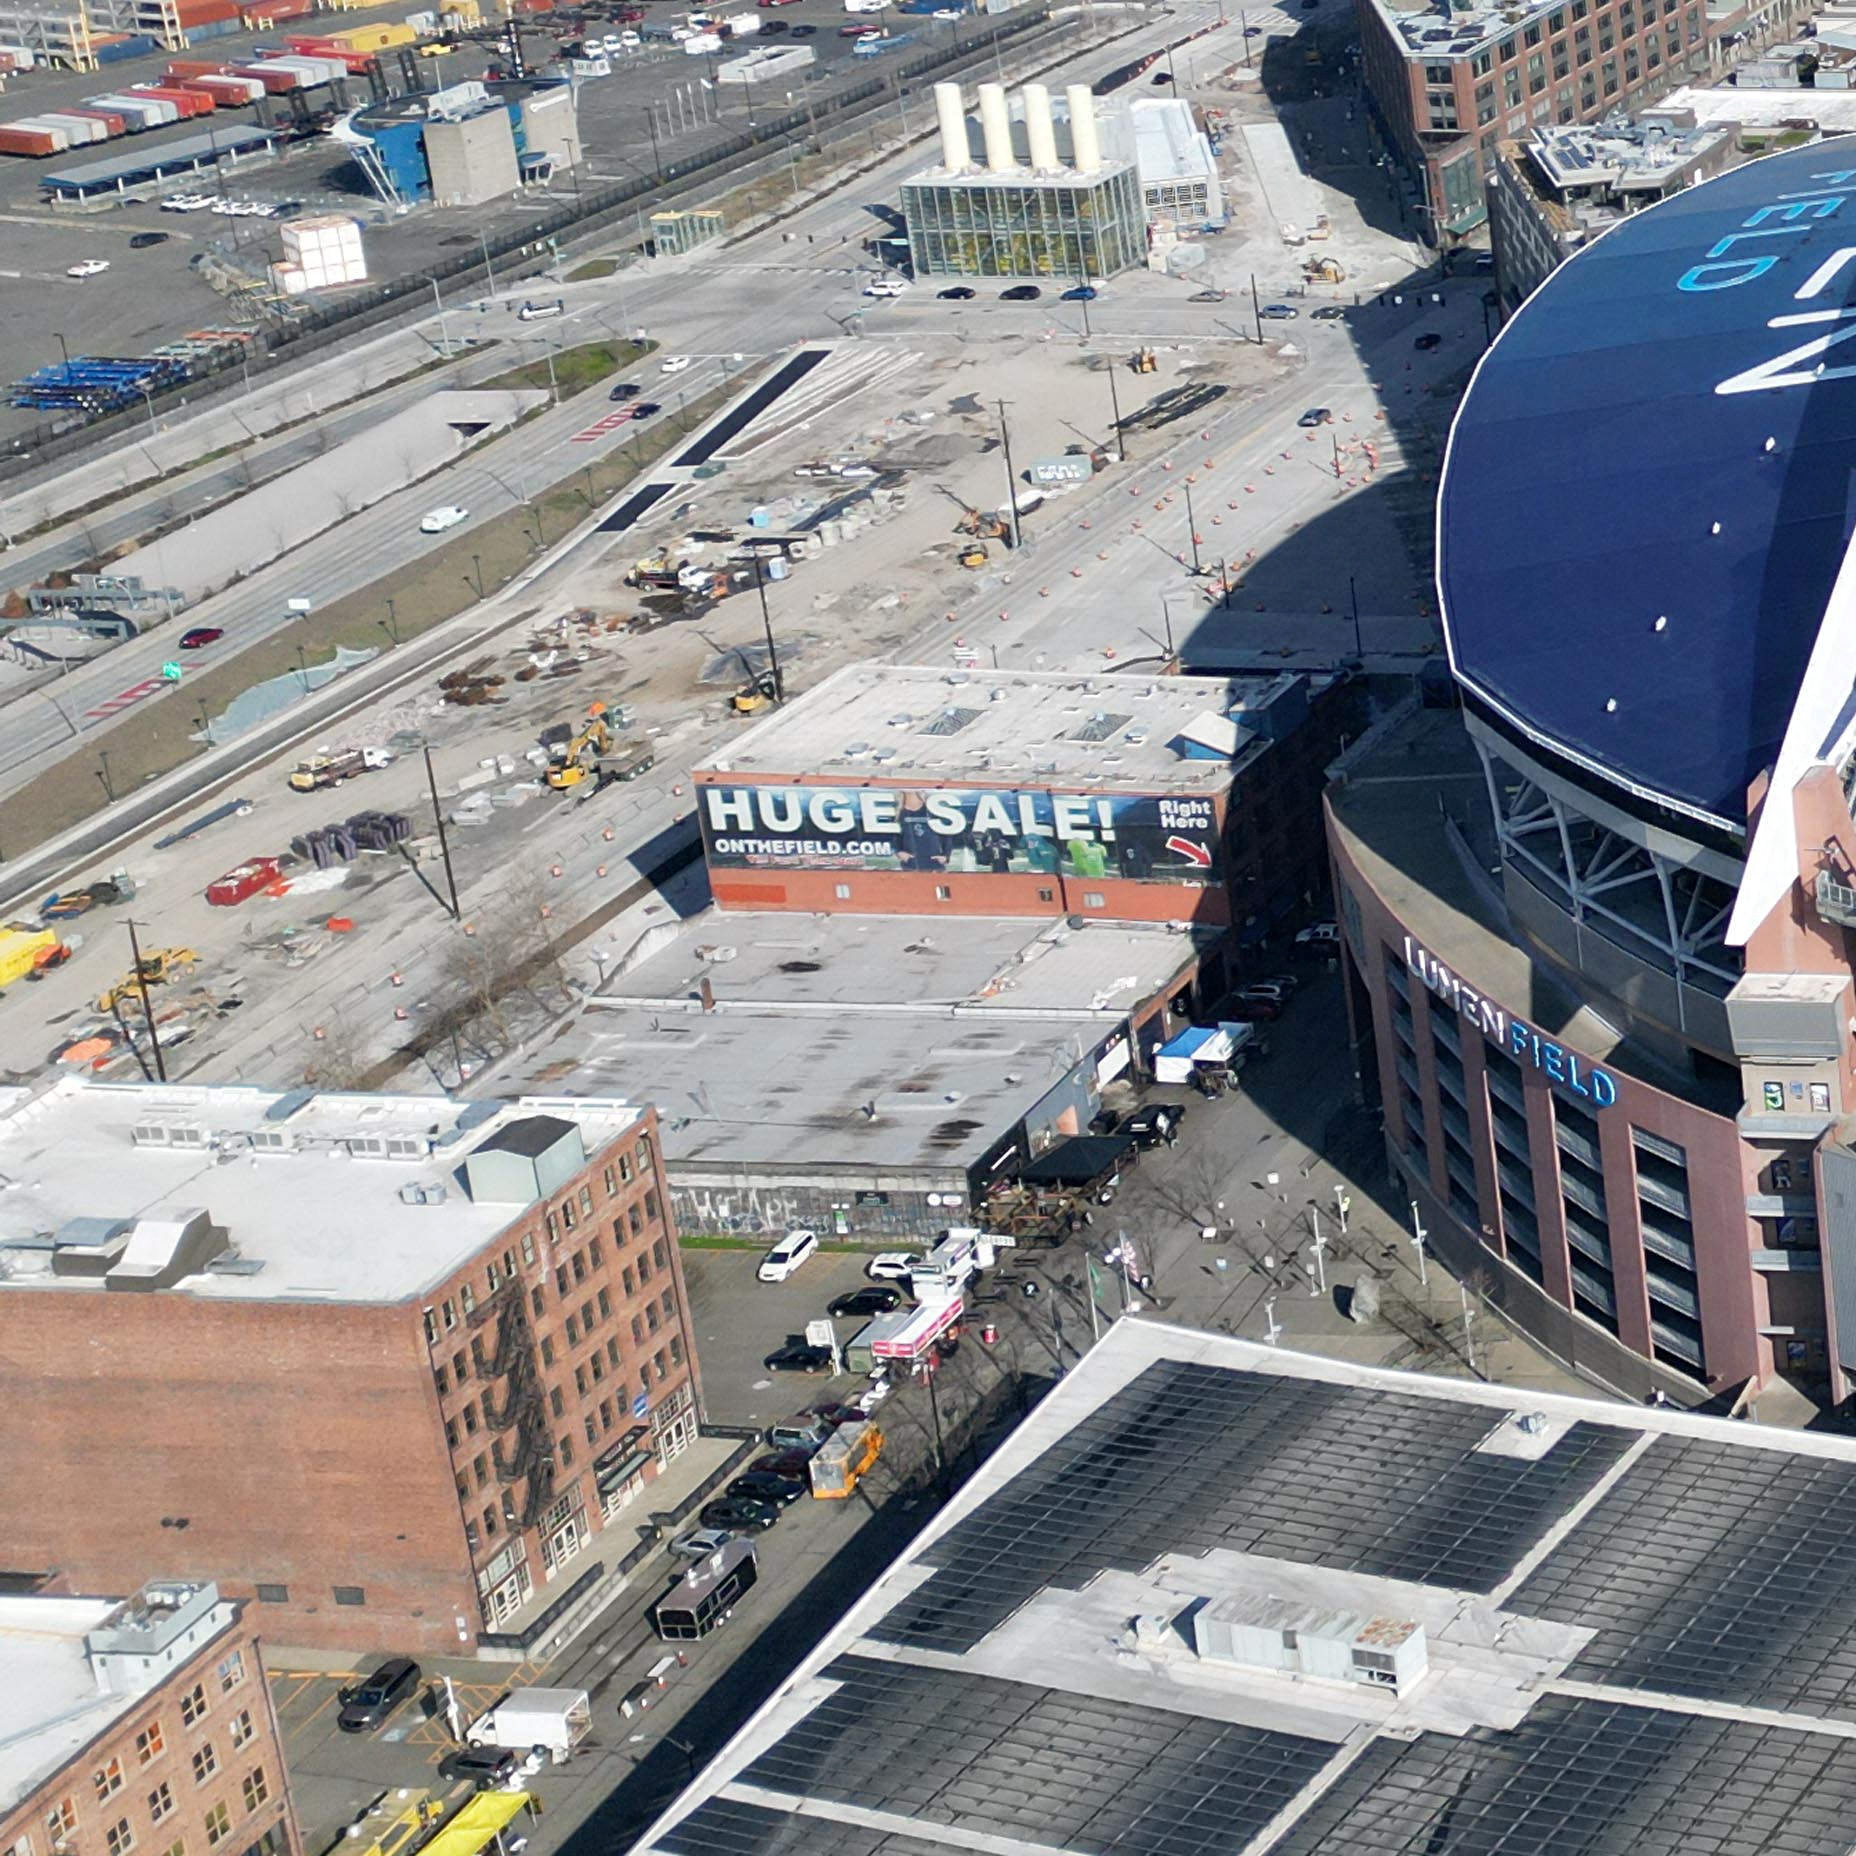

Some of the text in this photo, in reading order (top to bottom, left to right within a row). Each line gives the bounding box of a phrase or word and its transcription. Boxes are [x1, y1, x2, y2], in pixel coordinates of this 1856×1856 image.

[706, 788, 1116, 841] HUGE SALE!
[1158, 798, 1212, 818] Right
[1160, 812, 1209, 830] Here
[714, 838, 892, 857] ONTHEFIELD.COM
[1403, 935, 1618, 1108] LUMEN FIELD
